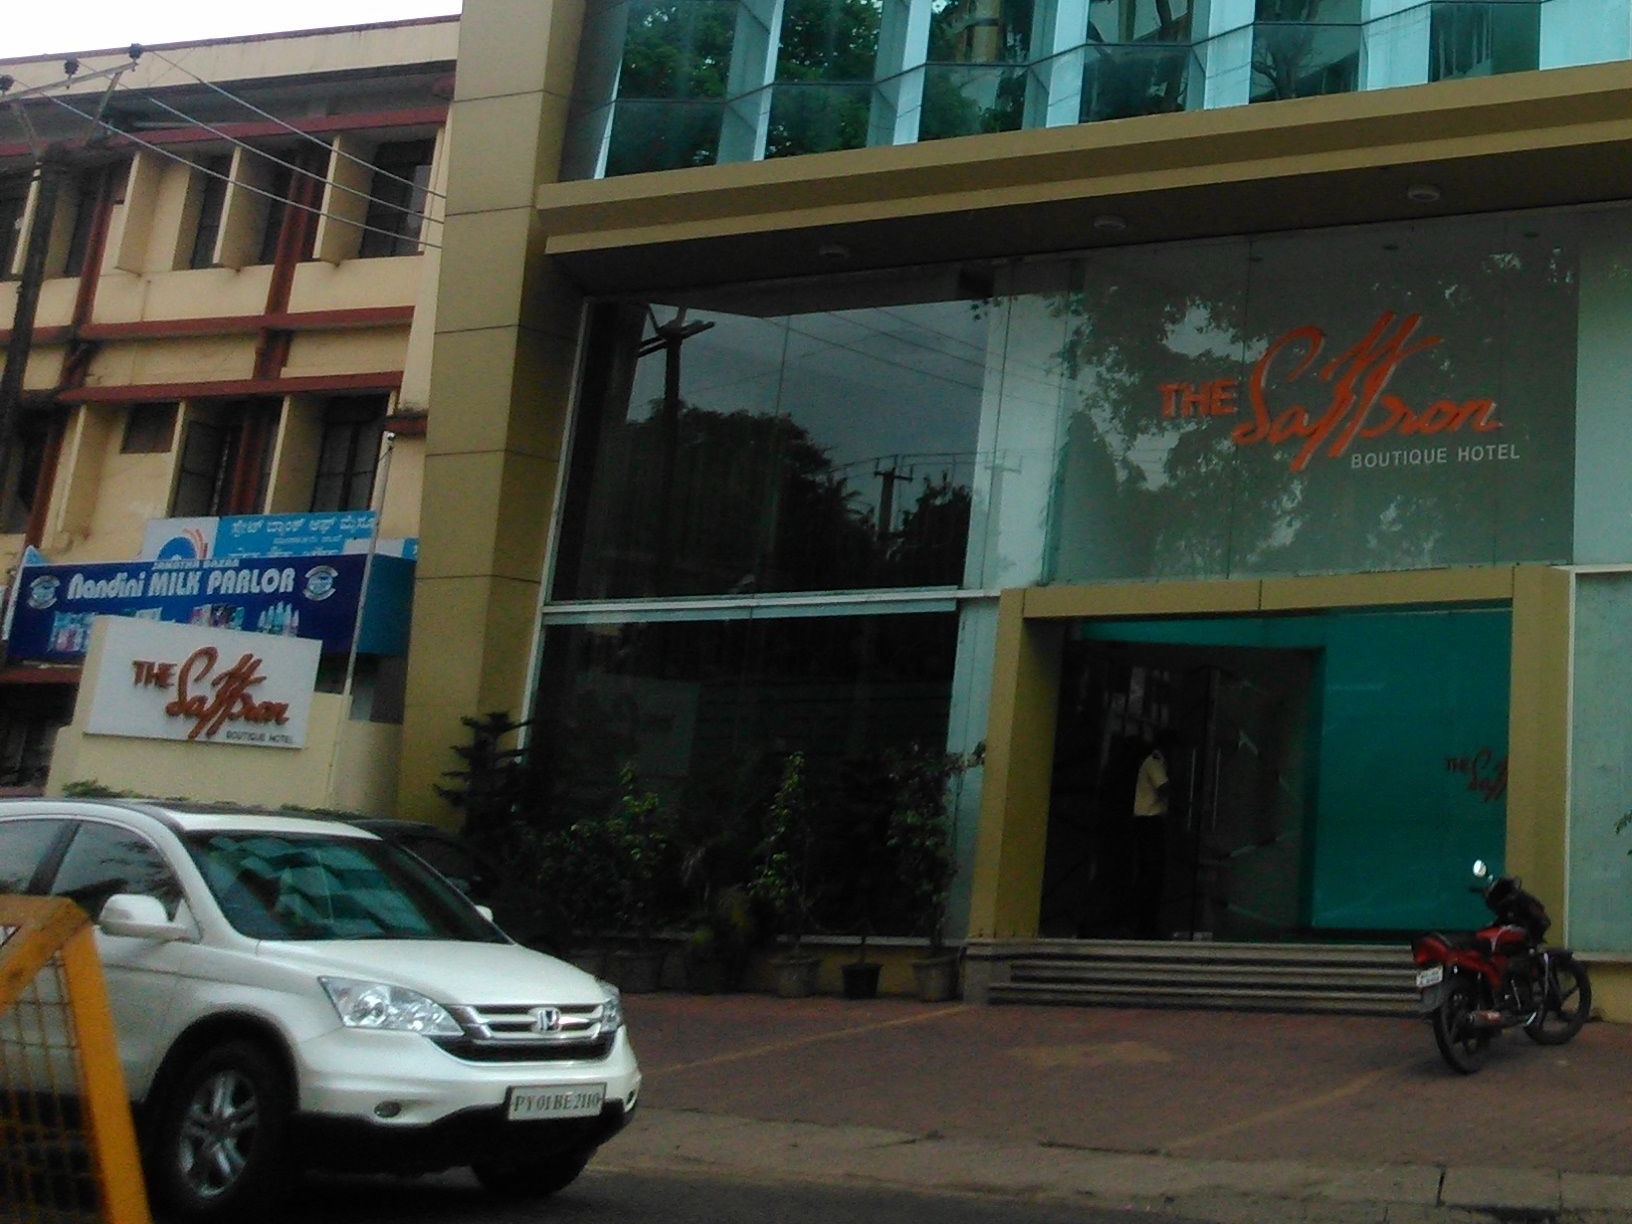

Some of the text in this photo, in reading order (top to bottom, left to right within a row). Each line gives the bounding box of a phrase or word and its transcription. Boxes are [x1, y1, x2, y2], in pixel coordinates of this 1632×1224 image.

[1158, 310, 1503, 473] THE Saffron
[1351, 443, 1521, 469] BOUTIQUE HOTEL
[148, 571, 202, 597] MILK
[207, 568, 296, 596] PARLOR
[132, 660, 178, 689] THE
